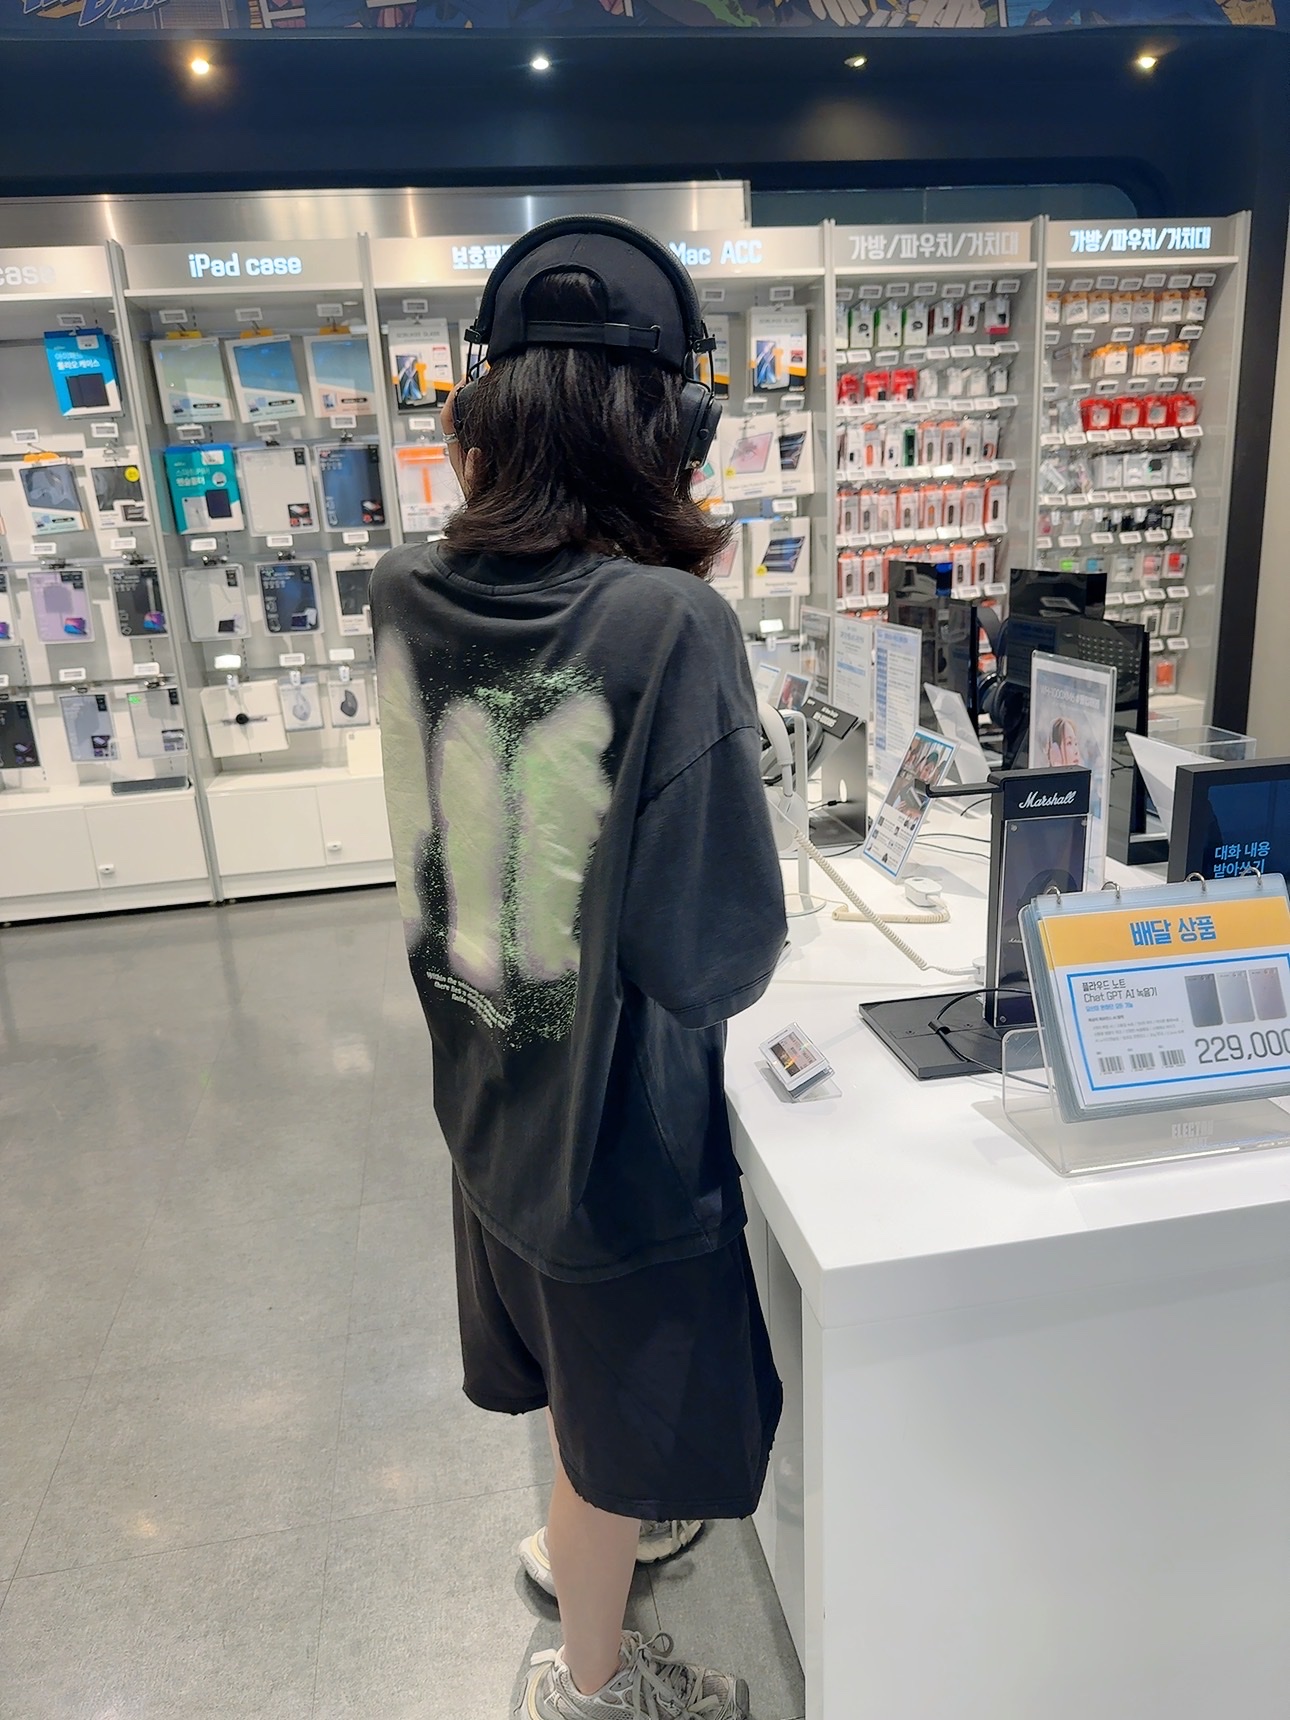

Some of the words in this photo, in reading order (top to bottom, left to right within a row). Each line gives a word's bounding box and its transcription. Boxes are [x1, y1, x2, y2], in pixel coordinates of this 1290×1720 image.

[848, 231, 1019, 261] 가방/파우치/거치대
[1069, 226, 1212, 253] 가방/파우치/거치대
[668, 241, 711, 265] Mac
[719, 239, 763, 265] ACC
[188, 252, 241, 278] iPad
[245, 256, 303, 276] case
[1018, 790, 1077, 809] Marshall
[1214, 843, 1242, 861] 대화
[1244, 841, 1271, 858] 내용
[1213, 858, 1265, 879] 받아쓰기
[1129, 919, 1172, 946] 배달
[1178, 915, 1217, 943] 상품
[1082, 979, 1110, 992] 플라우드
[1111, 978, 1127, 989] 노트
[1083, 992, 1105, 1003] Chat
[1106, 990, 1122, 1001] GPT
[1125, 989, 1135, 999] AI
[1136, 986, 1158, 997] 녹음기
